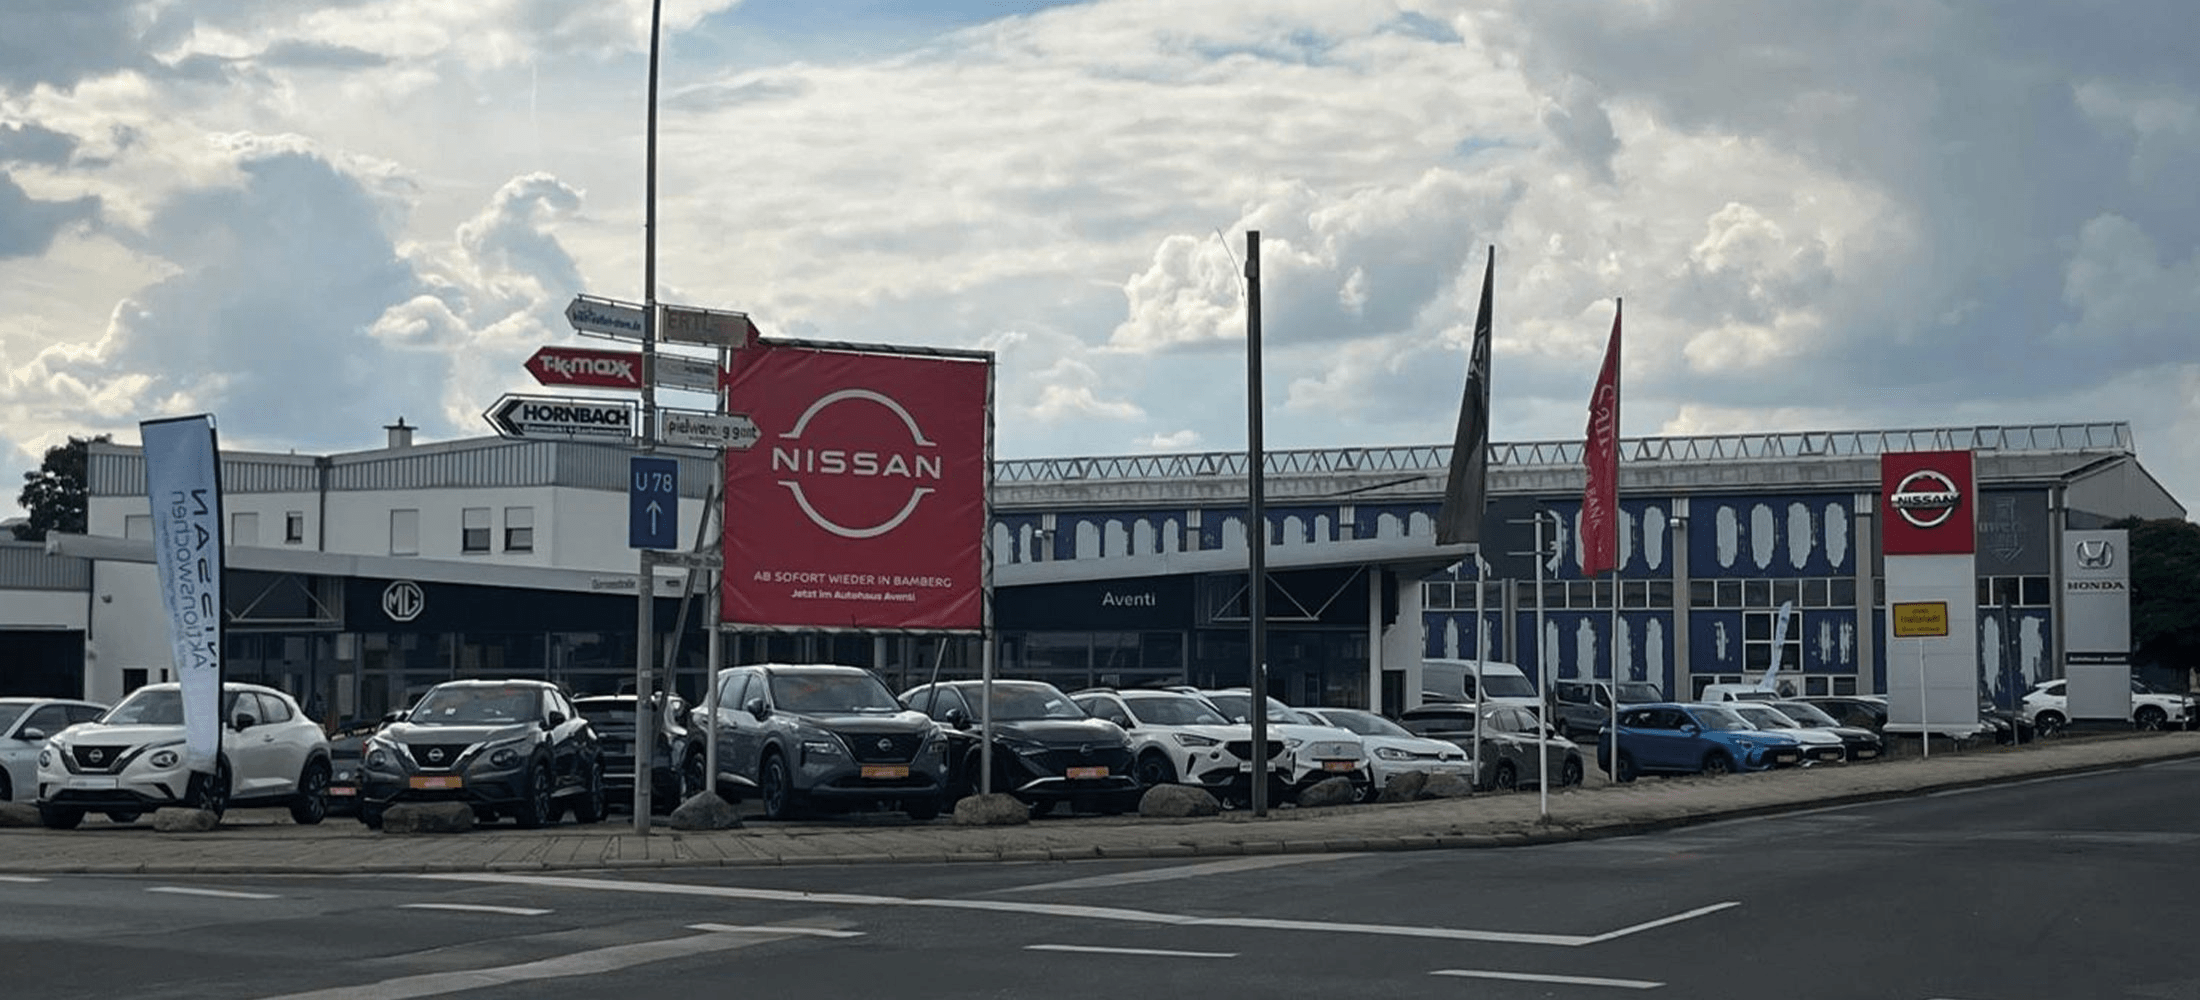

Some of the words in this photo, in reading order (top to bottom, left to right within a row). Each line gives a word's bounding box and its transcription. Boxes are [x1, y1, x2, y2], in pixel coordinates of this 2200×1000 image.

[523, 404, 630, 425] HORNBACH
[772, 447, 941, 480] NISSAN
[636, 472, 648, 491] U
[653, 473, 673, 493] 78
[1898, 493, 1955, 506] NISSAN
[754, 571, 771, 582] AB
[775, 571, 826, 583] SOFORT
[829, 573, 875, 585] WIEDER
[878, 575, 891, 586] IN
[894, 576, 952, 588] BAMBERG
[2067, 581, 2125, 590] HONDA
[388, 585, 419, 616] MG
[792, 589, 817, 599] Jetzt
[834, 590, 882, 600] Autohaus
[1101, 591, 1157, 607] Aventi
